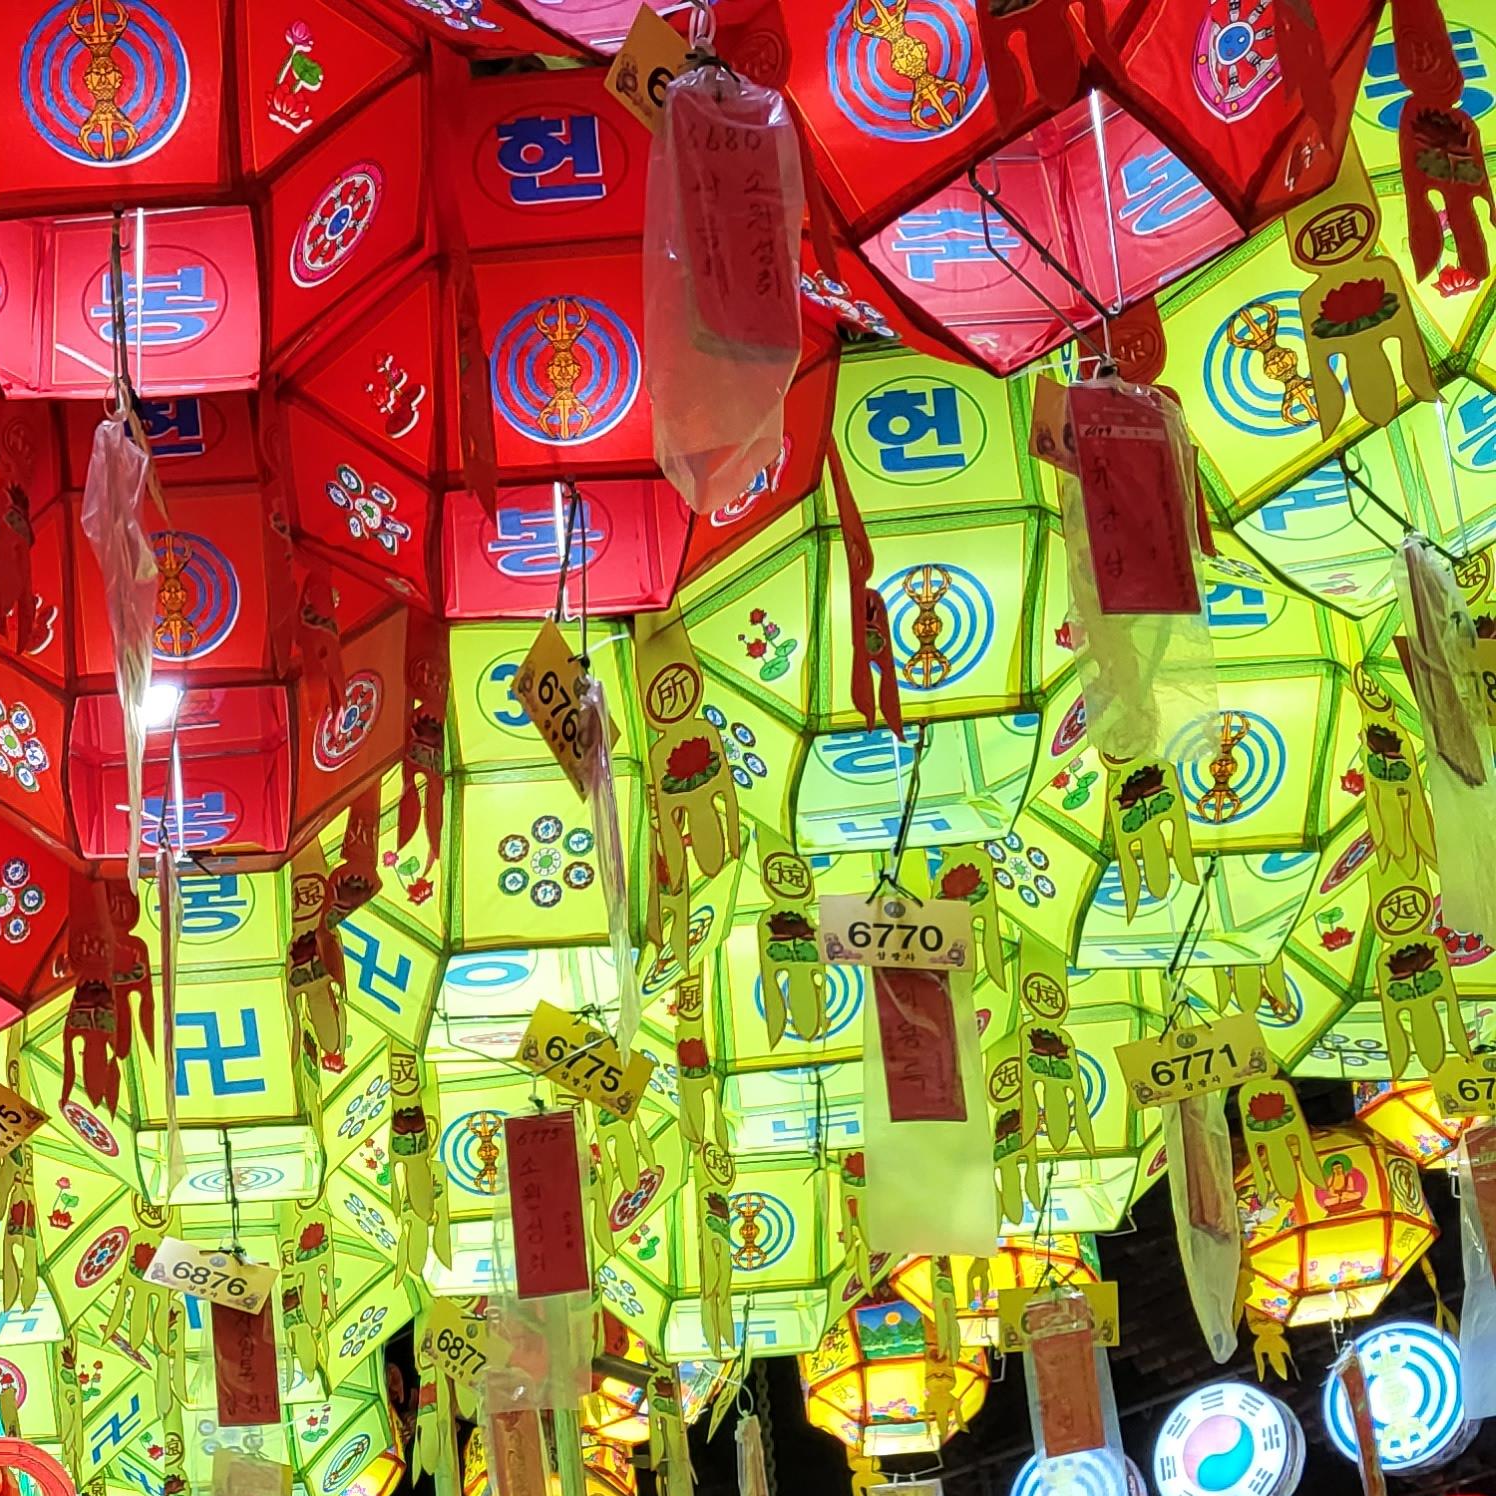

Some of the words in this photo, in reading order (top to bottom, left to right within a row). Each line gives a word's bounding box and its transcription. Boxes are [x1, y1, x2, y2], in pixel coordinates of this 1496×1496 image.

[495, 115, 607, 205] 헌
[1307, 210, 1366, 262] 願
[864, 386, 967, 473] 헌
[538, 671, 582, 758] 676
[847, 923, 945, 953] 6770
[545, 1036, 623, 1094] 6775
[1150, 1044, 1240, 1088] 6771
[172, 1260, 249, 1296] 6876
[436, 1328, 488, 1375] 6877
